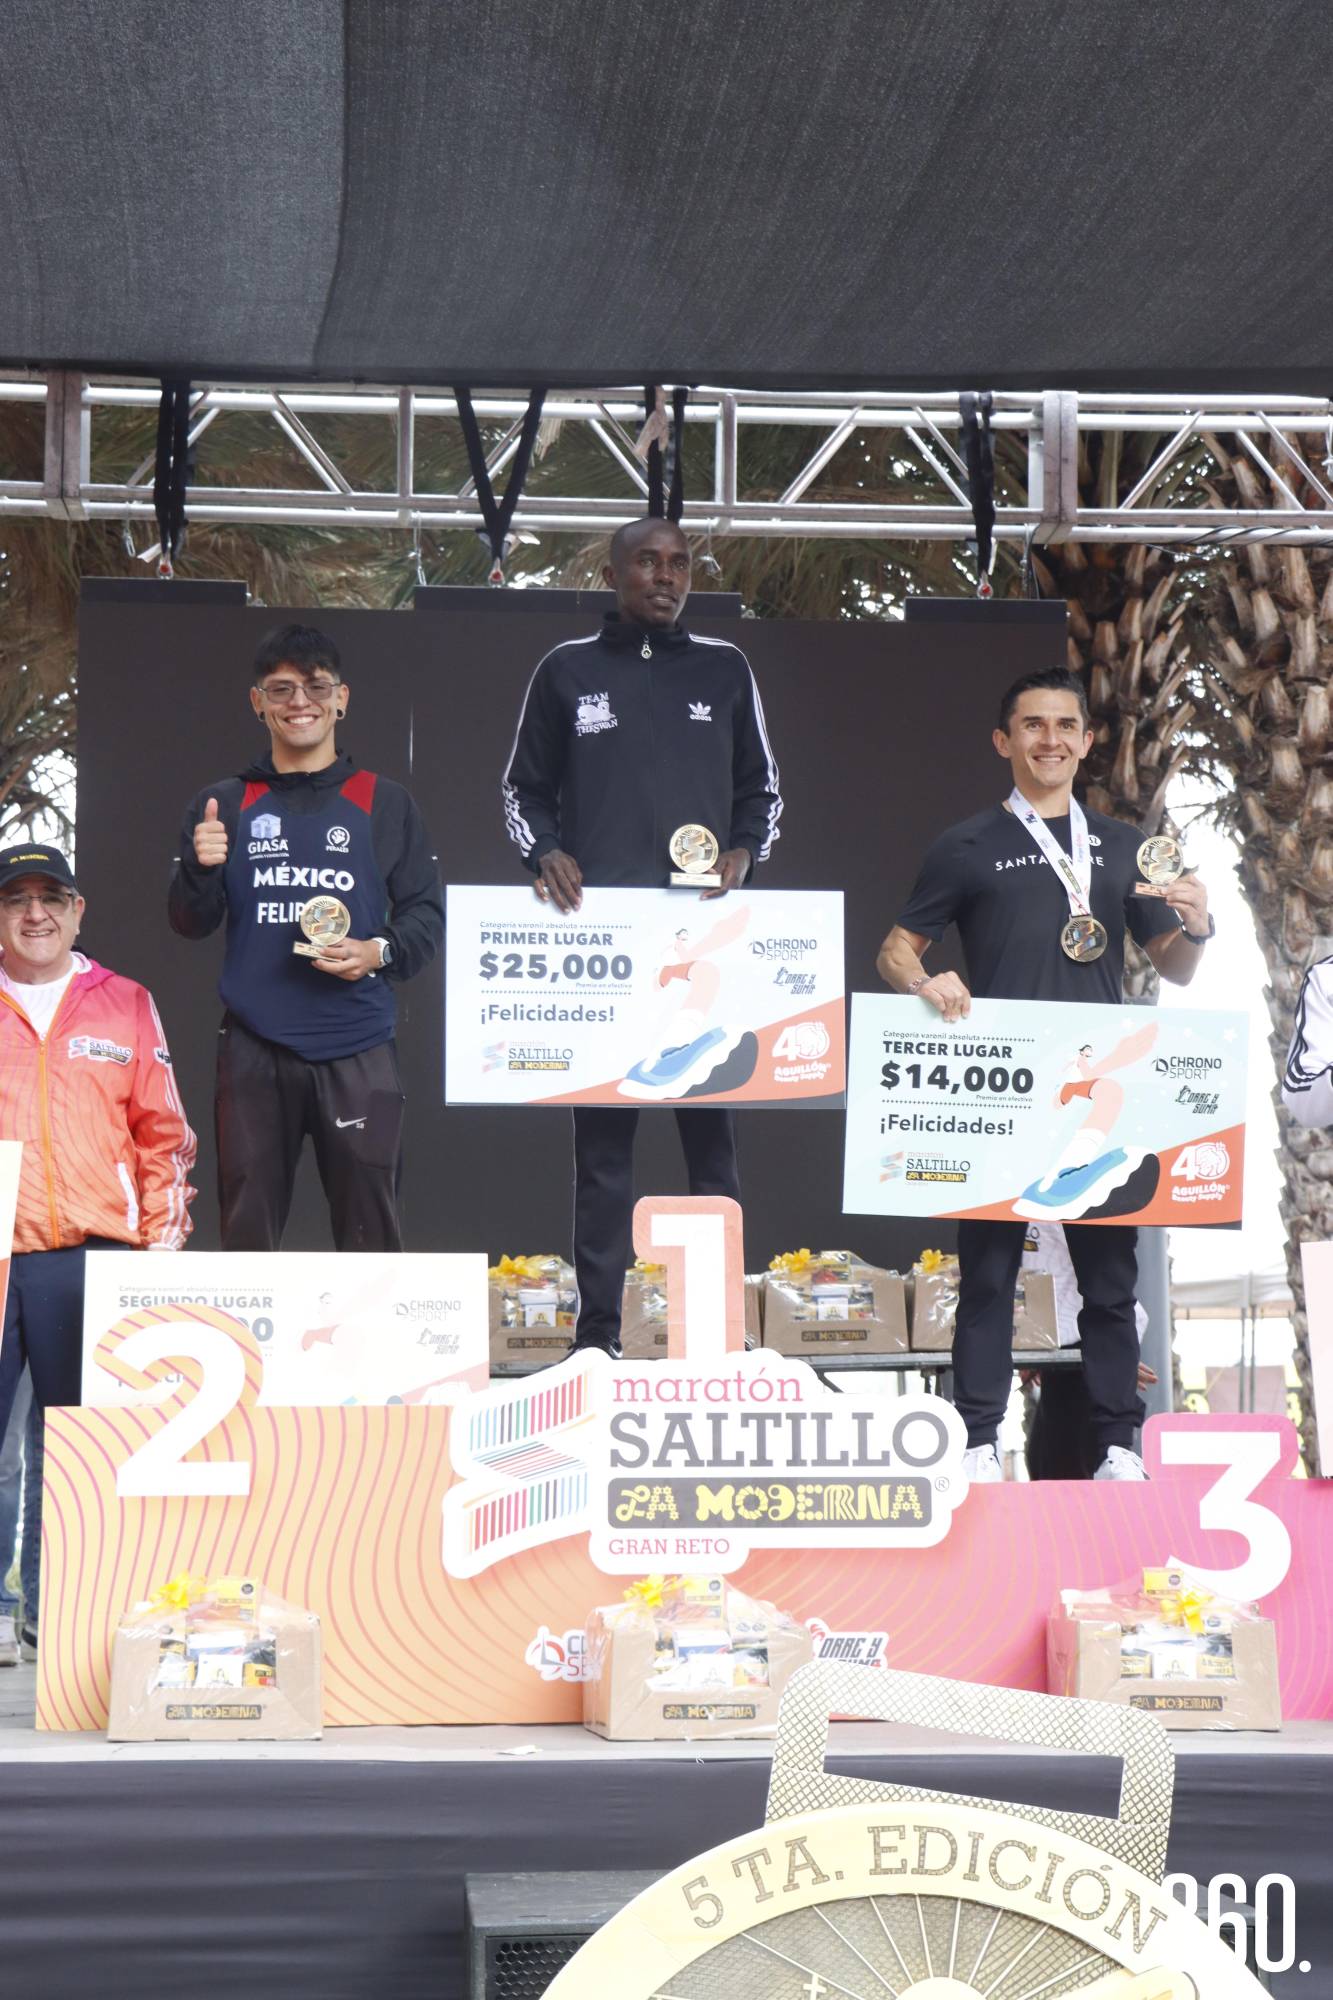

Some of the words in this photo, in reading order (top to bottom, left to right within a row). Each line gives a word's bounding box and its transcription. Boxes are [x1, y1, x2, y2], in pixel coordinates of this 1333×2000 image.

[578, 692, 609, 705] TEAM
[248, 839, 288, 854] GIASA
[253, 861, 355, 891] MÉXICO
[480, 931, 549, 945] PRIMER
[554, 932, 613, 946] LUGAR
[766, 938, 817, 950] CHRONO
[766, 949, 805, 961] SPORT
[479, 950, 633, 983] $25,000
[481, 1003, 615, 1025] ¡Felicidades!
[948, 1033, 980, 1041] absoluta
[508, 1048, 574, 1060] SALTILLO
[883, 1040, 949, 1056] TERCER
[954, 1043, 1013, 1059] LUGAR
[1170, 1056, 1222, 1069] CHRONO
[880, 1060, 1034, 1095] $14,000
[1169, 1067, 1209, 1080] SPORT
[880, 1114, 1013, 1136] ¡Felicidades!
[906, 1158, 971, 1172] SALTILLO
[651, 1214, 724, 1358] 1
[214, 1296, 273, 1309] LUGAR
[410, 1299, 462, 1311] CHRONO
[612, 1368, 804, 1402] maratón
[112, 1322, 250, 1497] 2
[609, 1411, 949, 1469] SALTILLO
[615, 1484, 680, 1522] LA
[695, 1484, 924, 1522] MODERNA
[1161, 1431, 1291, 1602] 3
[609, 1540, 670, 1555] GRAN
[675, 1538, 730, 1555] RETO
[682, 1875, 724, 1929] 5
[731, 1836, 844, 1903] TA.
[867, 1824, 1168, 1954] EDICIÓN
